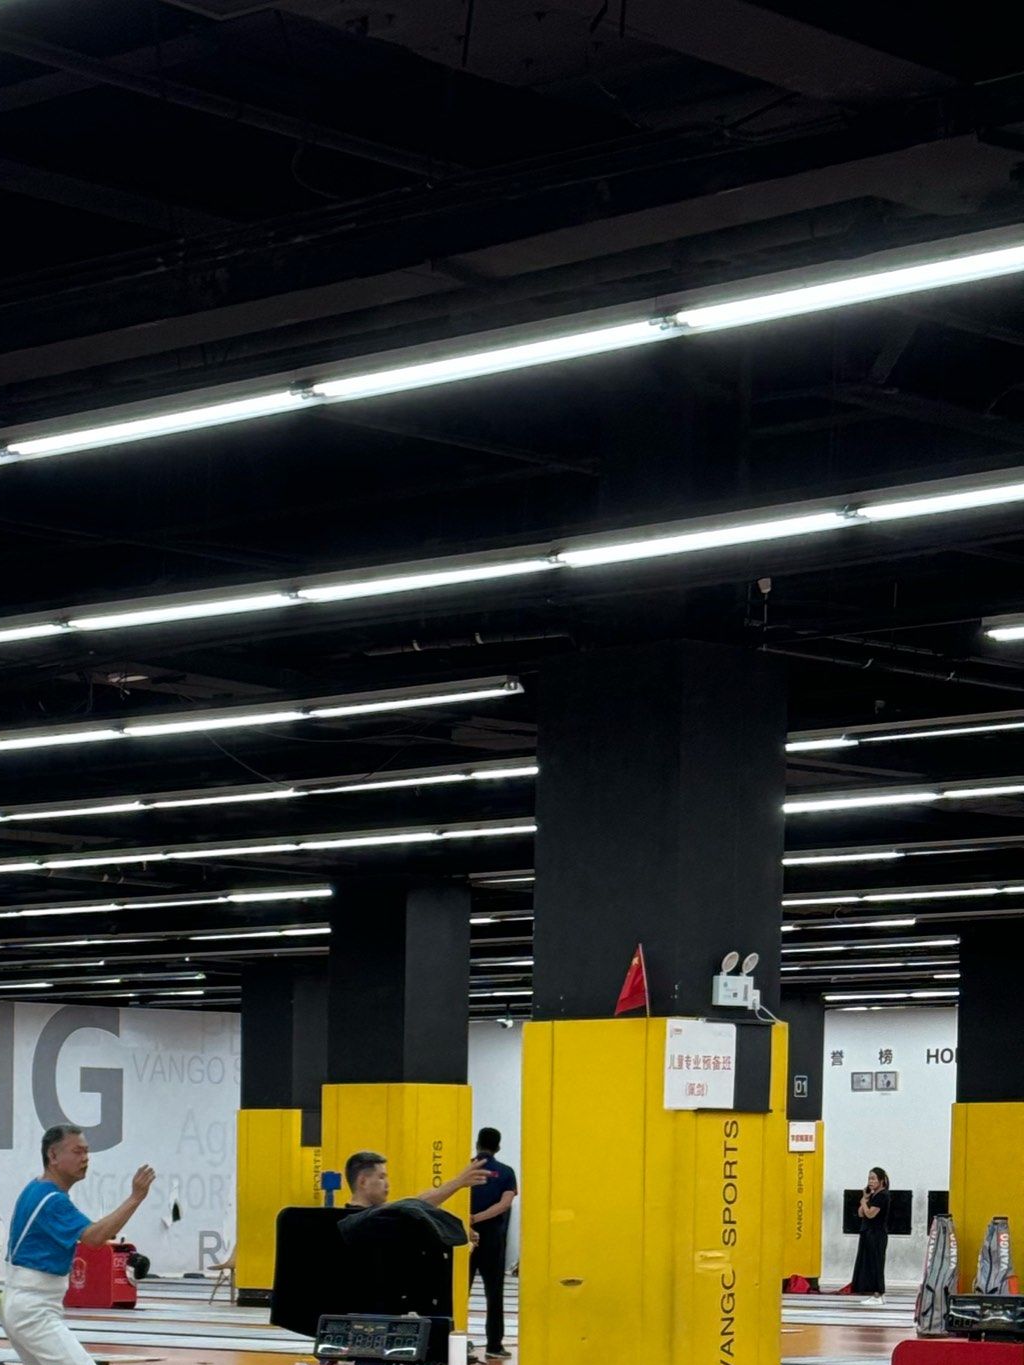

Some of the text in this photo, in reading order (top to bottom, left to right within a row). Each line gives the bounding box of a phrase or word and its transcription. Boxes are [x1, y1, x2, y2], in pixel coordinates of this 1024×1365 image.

[926, 1047, 957, 1065] HO
[432, 1140, 443, 1188] ORTS
[722, 1120, 739, 1247] SPORTS
